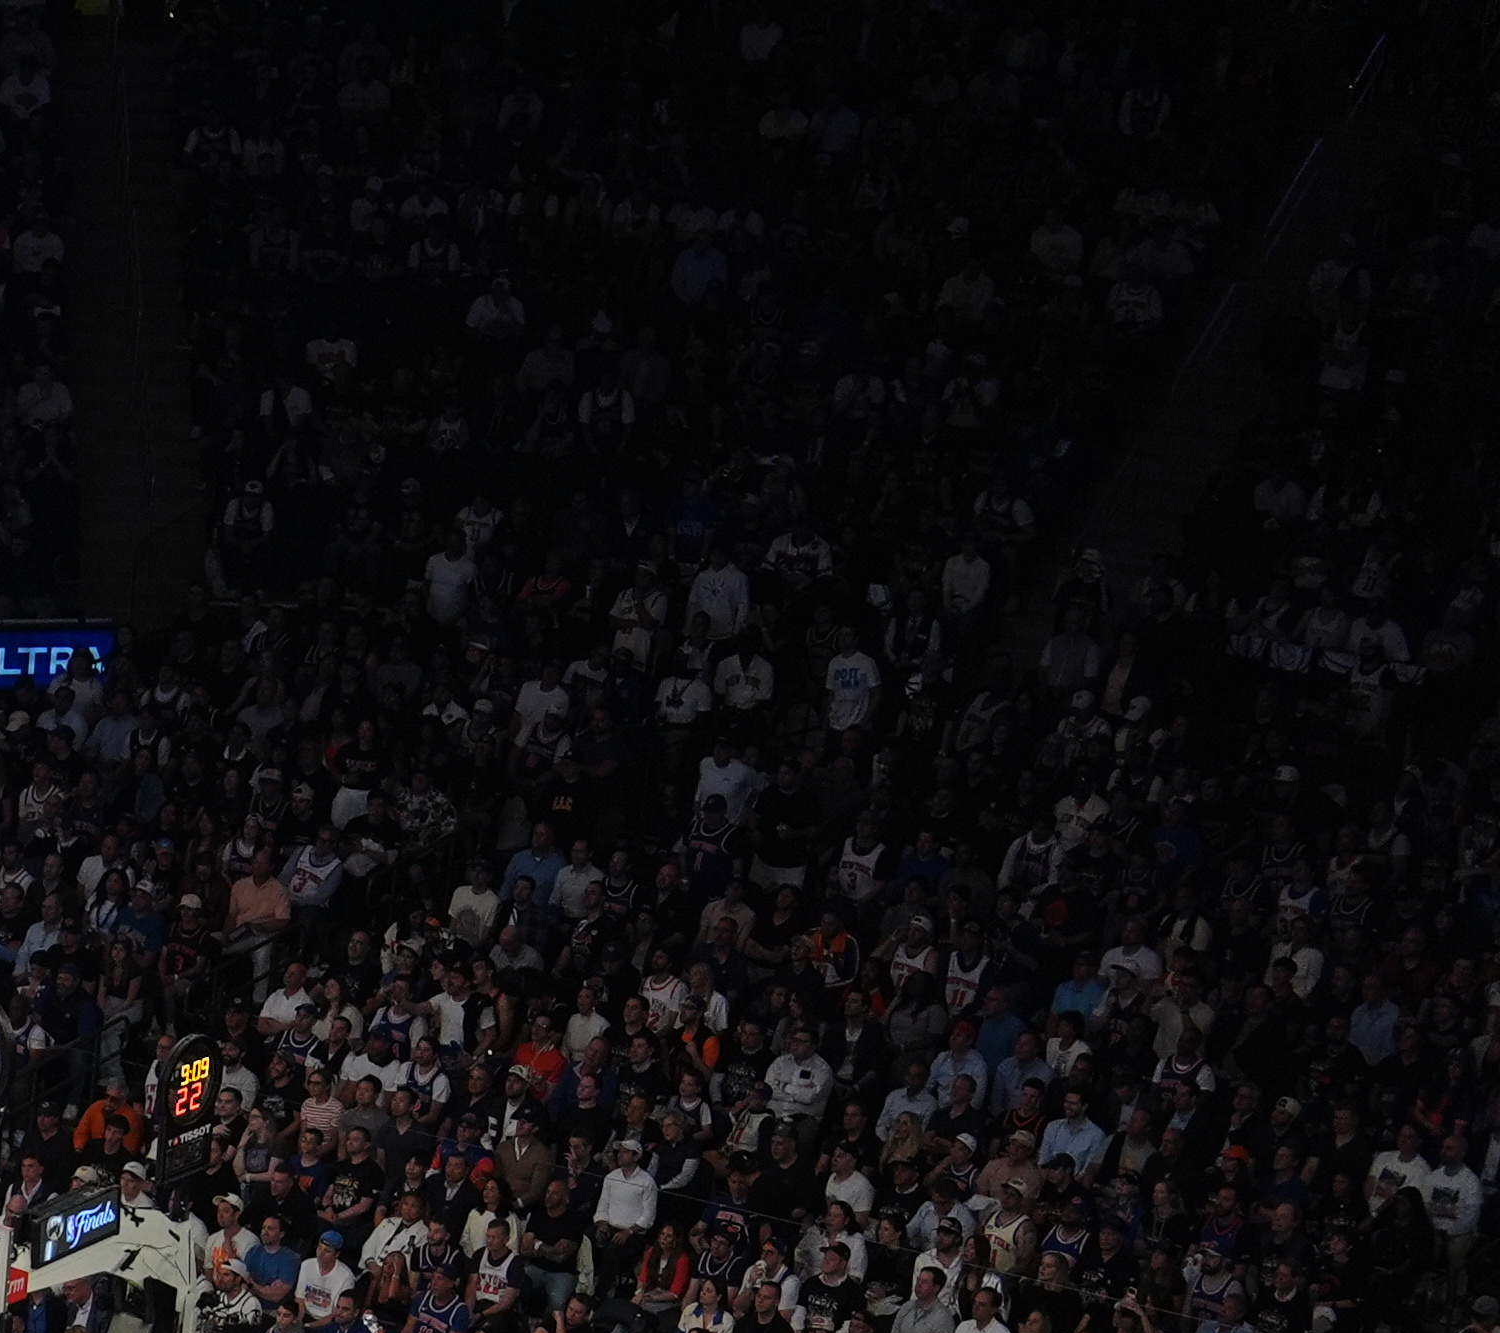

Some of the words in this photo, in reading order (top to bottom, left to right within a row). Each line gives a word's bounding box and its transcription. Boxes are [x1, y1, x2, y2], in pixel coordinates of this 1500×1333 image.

[181, 1056, 210, 1086] 9:09
[175, 1082, 203, 1116] 22
[179, 1123, 212, 1144] TISSOT
[70, 1200, 116, 1250] Finals
